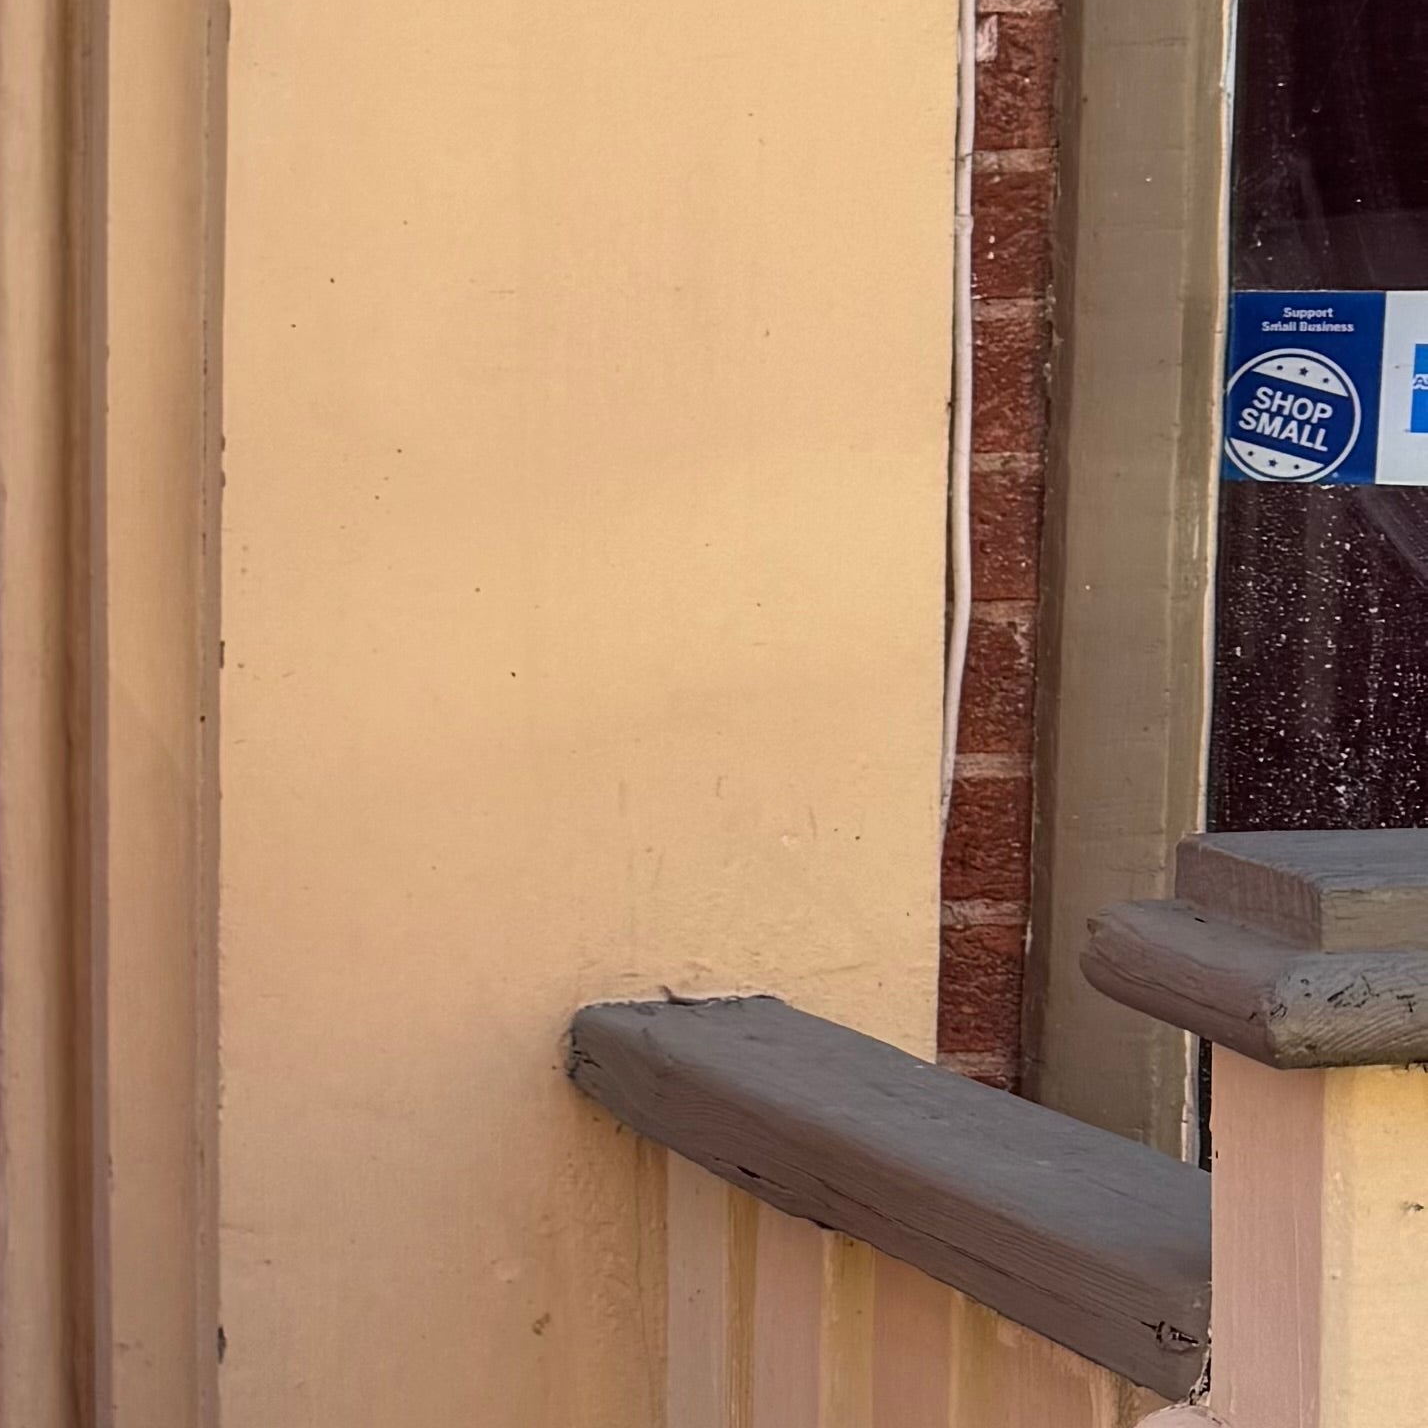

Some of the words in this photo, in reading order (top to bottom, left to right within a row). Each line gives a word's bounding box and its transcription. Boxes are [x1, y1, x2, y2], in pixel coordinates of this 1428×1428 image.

[1283, 307, 1334, 319] Support
[1261, 321, 1297, 332] Small
[1299, 321, 1355, 332] Business
[1252, 386, 1333, 424] SHOP
[1238, 408, 1329, 452] SMALL
